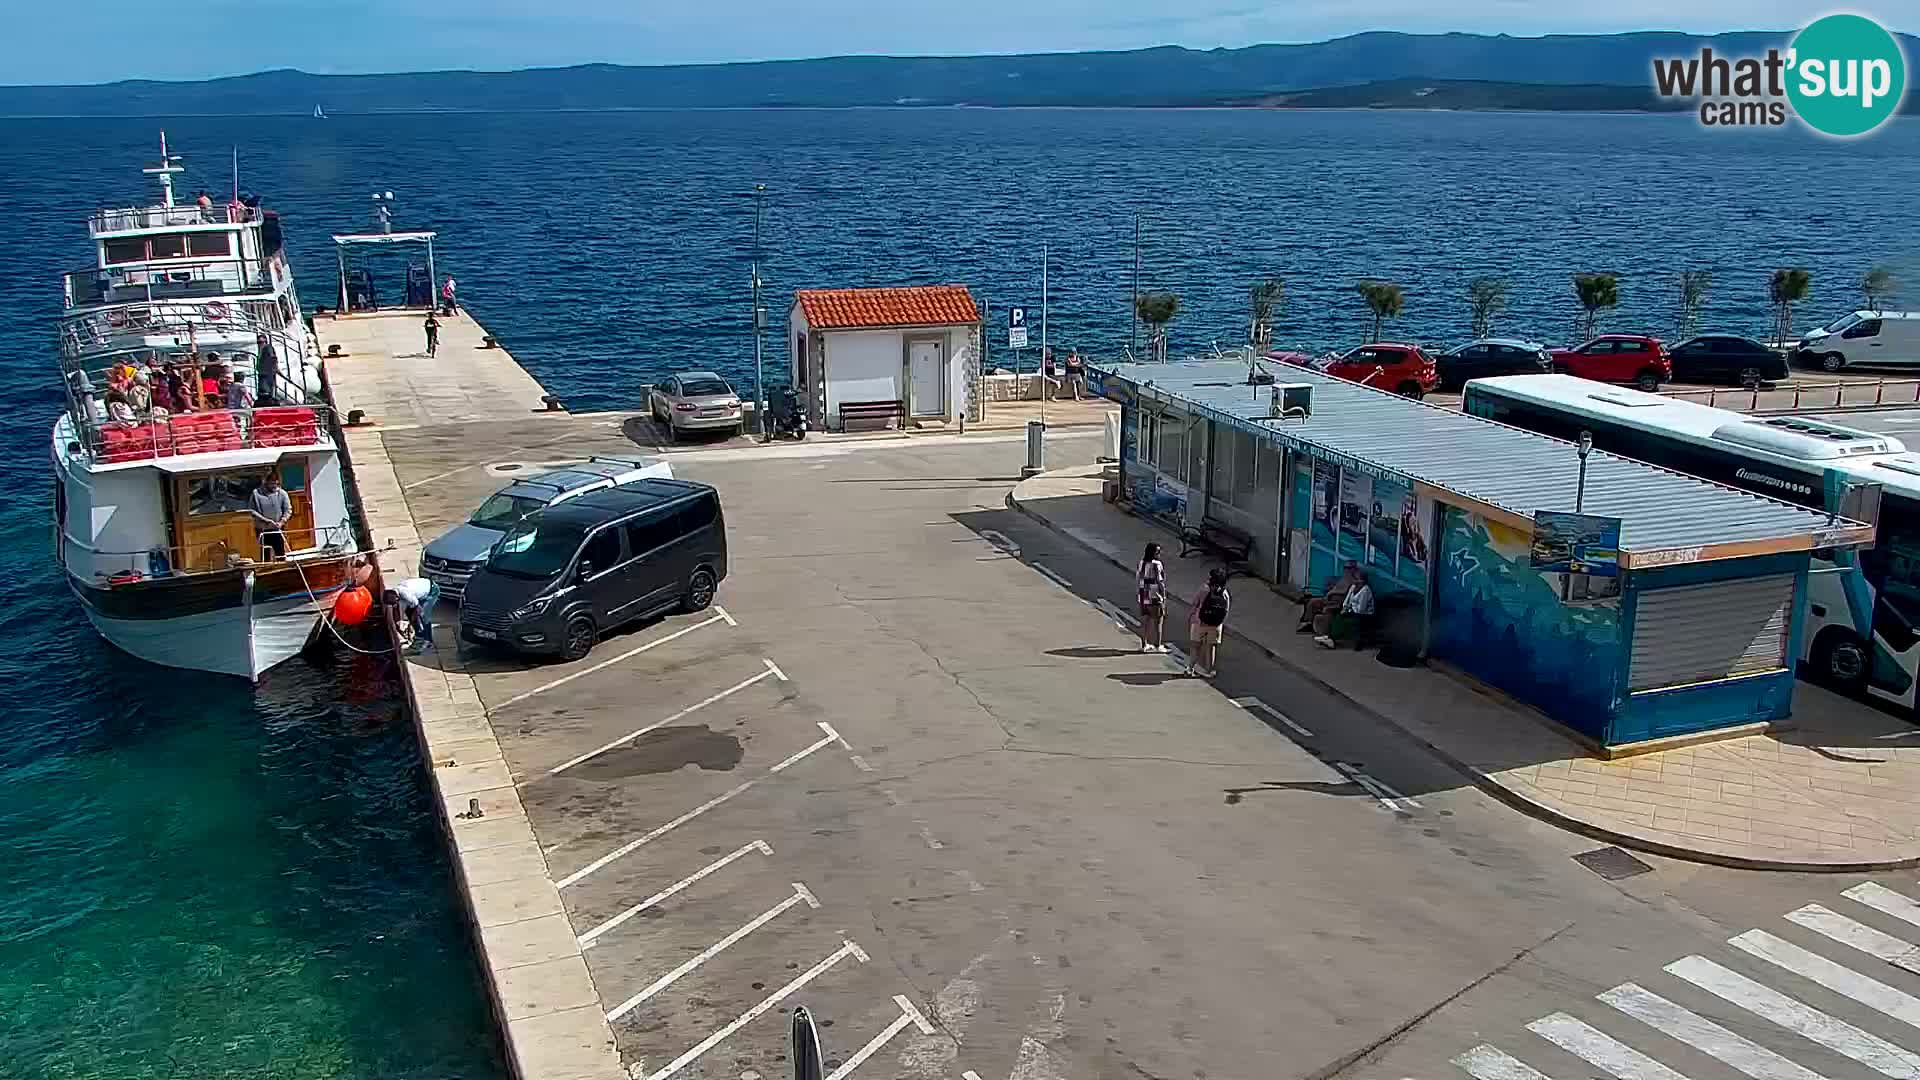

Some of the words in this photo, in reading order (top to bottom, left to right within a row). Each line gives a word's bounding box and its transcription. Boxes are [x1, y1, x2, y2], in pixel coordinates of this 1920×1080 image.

[1013, 308, 1024, 326] P
[1325, 451, 1356, 471] STATION
[1357, 462, 1382, 480] TICKET
[1383, 471, 1410, 488] OFFICE
